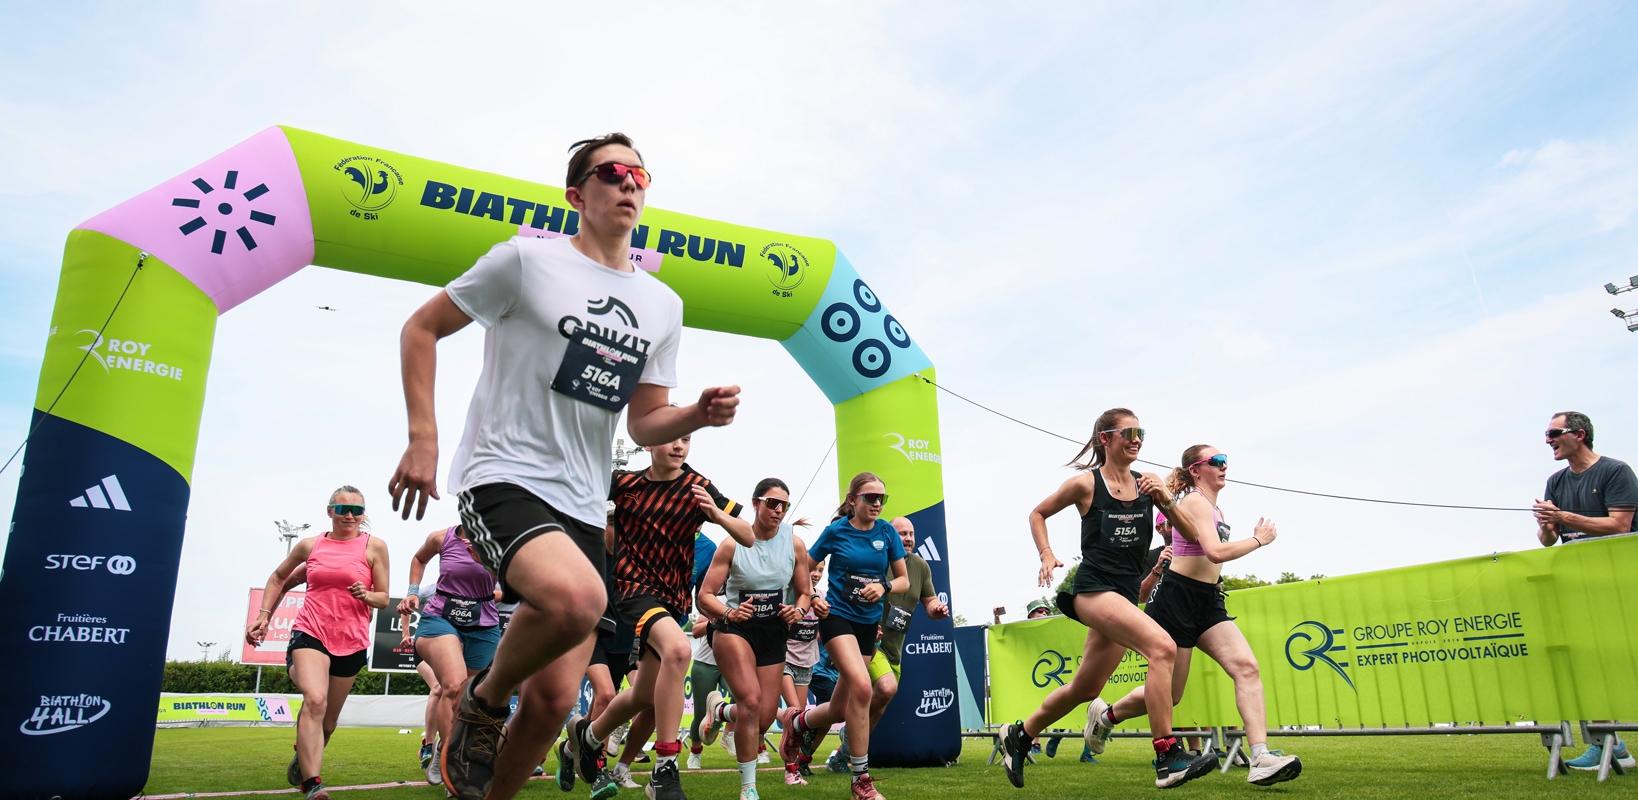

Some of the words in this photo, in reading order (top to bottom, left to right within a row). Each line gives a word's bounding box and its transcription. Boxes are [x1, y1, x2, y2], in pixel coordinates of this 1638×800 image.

[350, 209, 361, 218] de
[364, 212, 378, 220] Ski
[420, 180, 649, 250] BIATHLN
[656, 229, 746, 268] RUN
[782, 290, 793, 298] Ski
[108, 338, 152, 356] ROY
[582, 337, 622, 358] BIATHLON
[622, 352, 639, 365] RUN
[106, 355, 183, 381] ENERGIE
[580, 364, 622, 390] 516A
[908, 439, 930, 450] ROY
[1114, 526, 1137, 536] 515A
[56, 613, 107, 624] Fruitières
[450, 609, 472, 618] 506A
[28, 625, 130, 644] CHABERT
[1353, 622, 1414, 641] GROUPE
[1417, 618, 1448, 636] ROY
[1454, 612, 1523, 632] ENERGIE
[905, 642, 952, 655] CHABERT
[1357, 652, 1398, 667] EXPERT
[1402, 643, 1529, 664] PHOTOVOLTAÏQUE
[173, 702, 224, 710] BIATHLON
[226, 702, 246, 710] RUN
[921, 698, 950, 714] 4ALL
[30, 707, 89, 730] 4ALL
